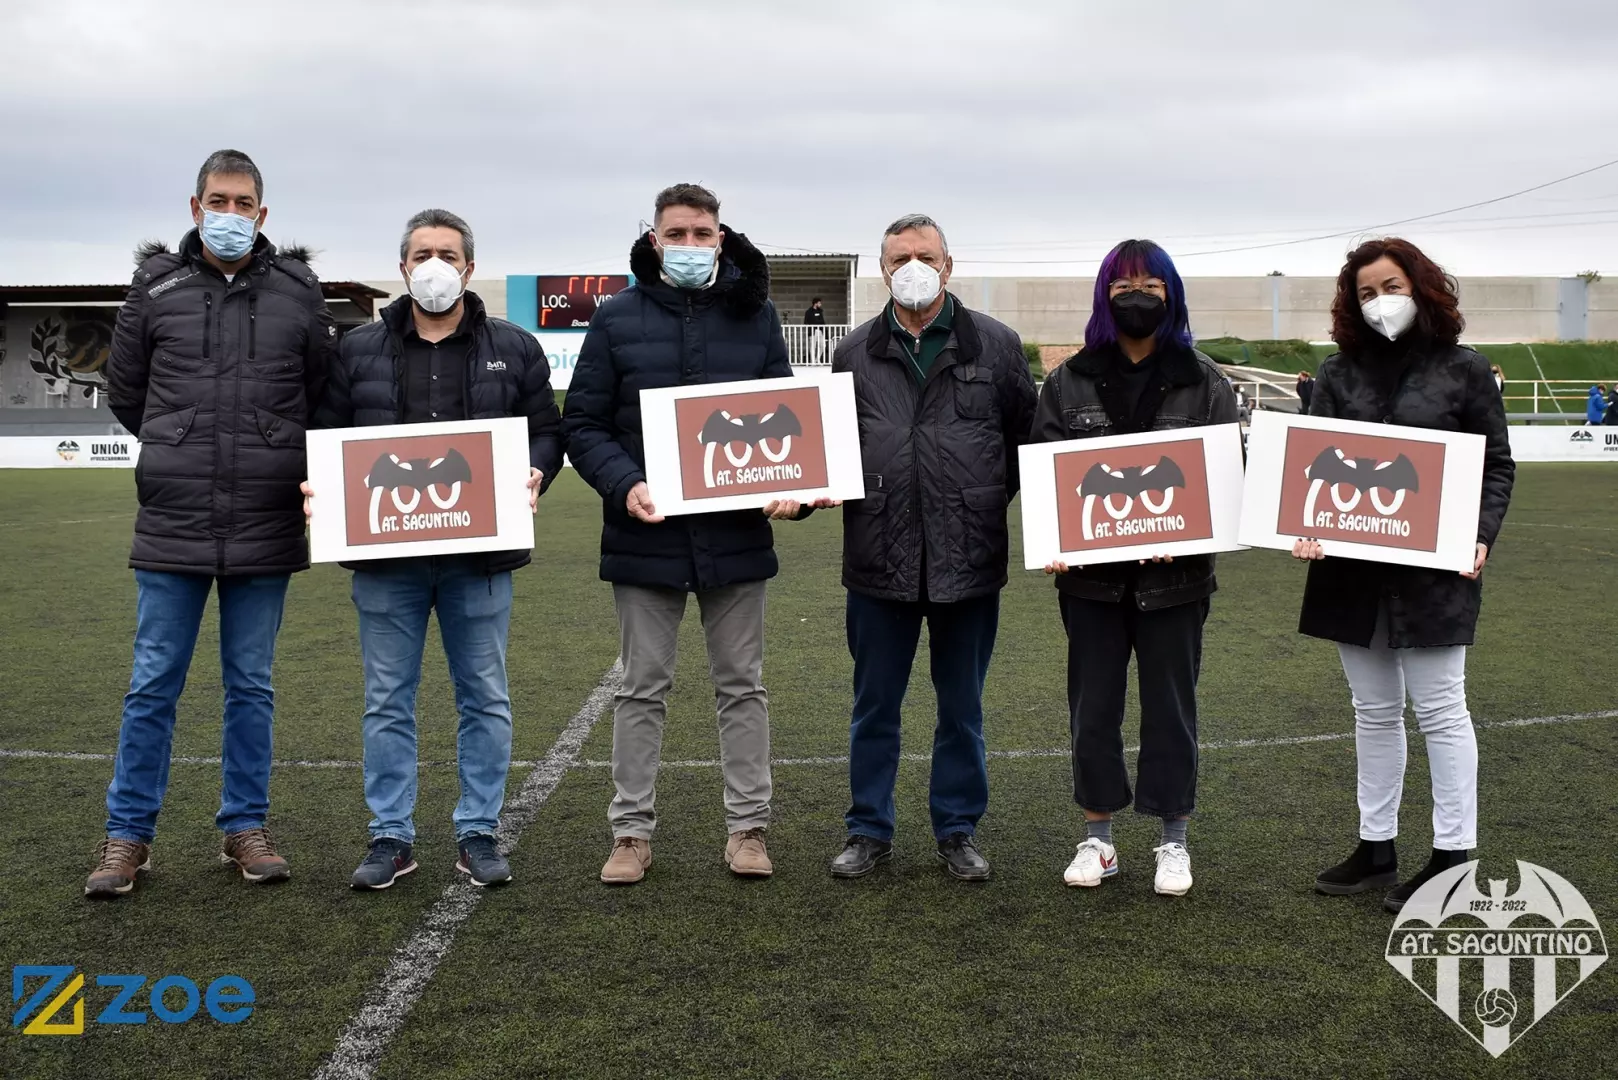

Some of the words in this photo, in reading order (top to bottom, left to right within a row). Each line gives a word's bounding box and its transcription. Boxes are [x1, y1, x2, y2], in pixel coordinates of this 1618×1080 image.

[541, 295, 571, 309] LOC.
[91, 441, 128, 455] UNIÓN
[716, 470, 733, 486] AT.
[736, 463, 802, 484] SAGUNTINO
[381, 516, 400, 533] AT.
[402, 510, 471, 531] SAGUNTINO
[1095, 522, 1113, 538] AT.
[1115, 514, 1185, 536] SAGUNTINO
[1315, 510, 1334, 528] AT.
[1337, 512, 1410, 537] SAGUNTINO
